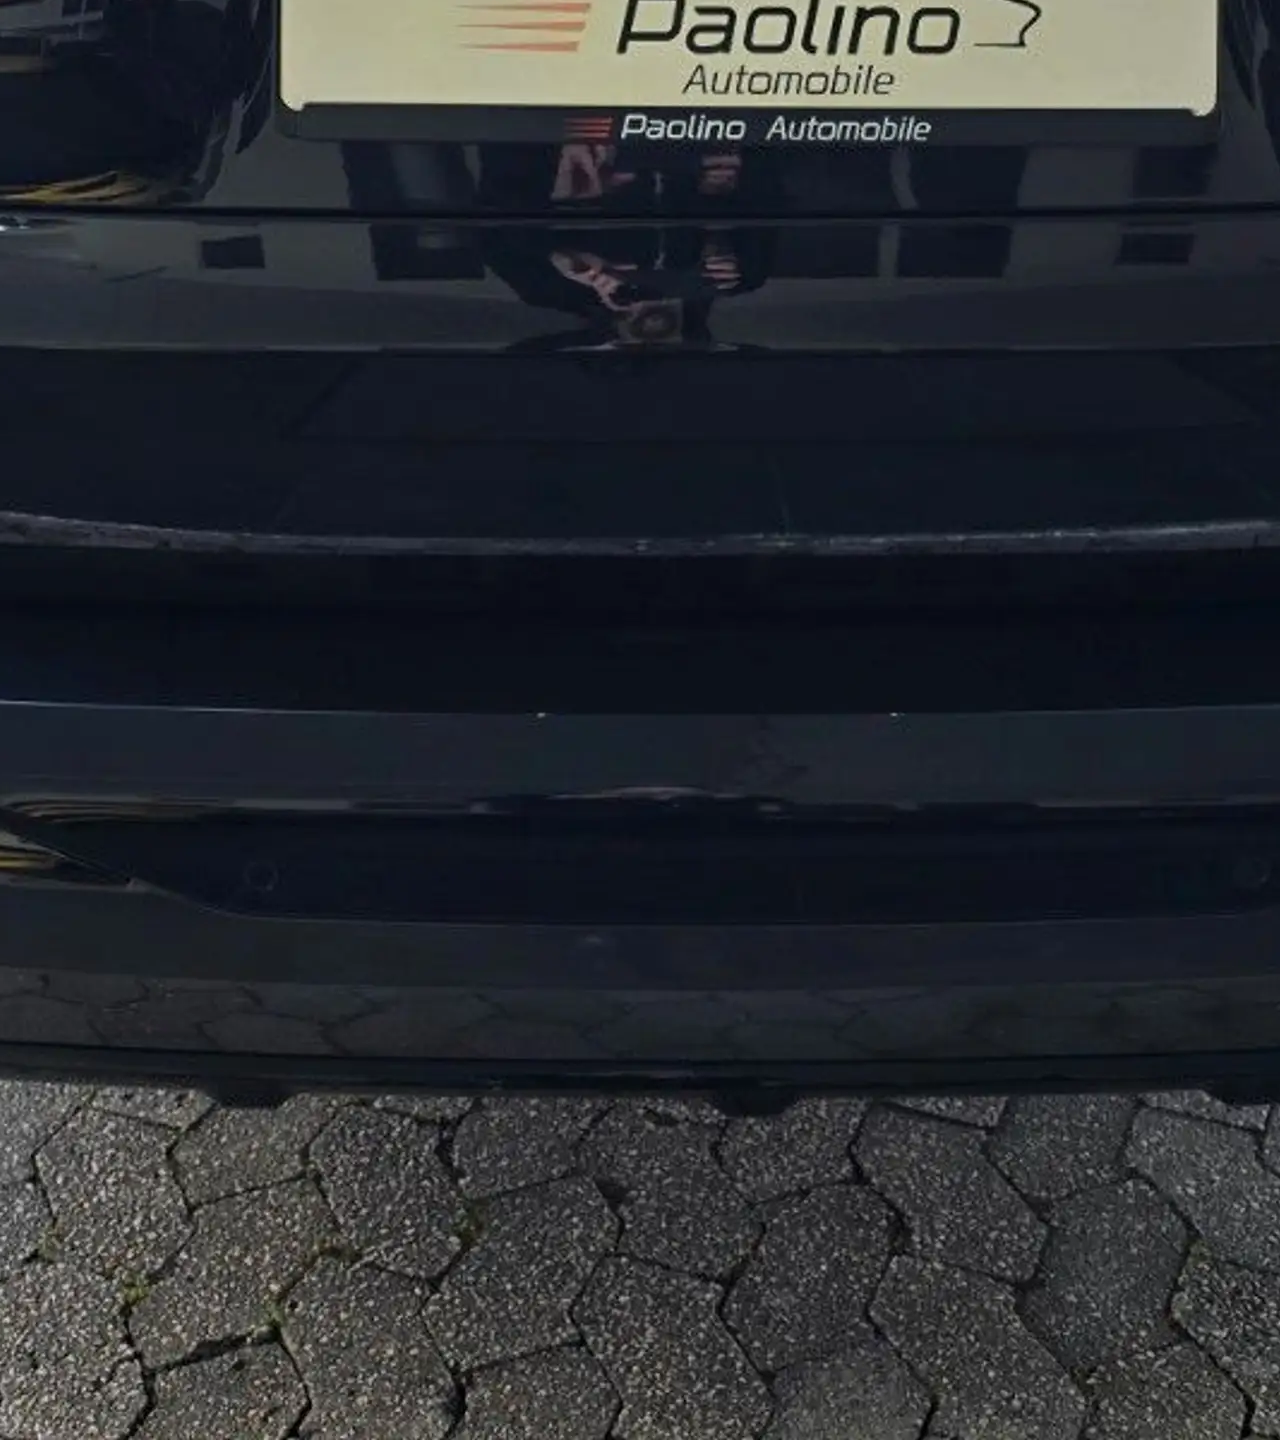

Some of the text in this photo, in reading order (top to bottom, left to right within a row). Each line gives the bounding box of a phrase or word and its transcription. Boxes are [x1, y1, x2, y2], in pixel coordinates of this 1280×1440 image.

[681, 63, 895, 96] Automobile
[620, 112, 933, 143] Paolino Automobile
